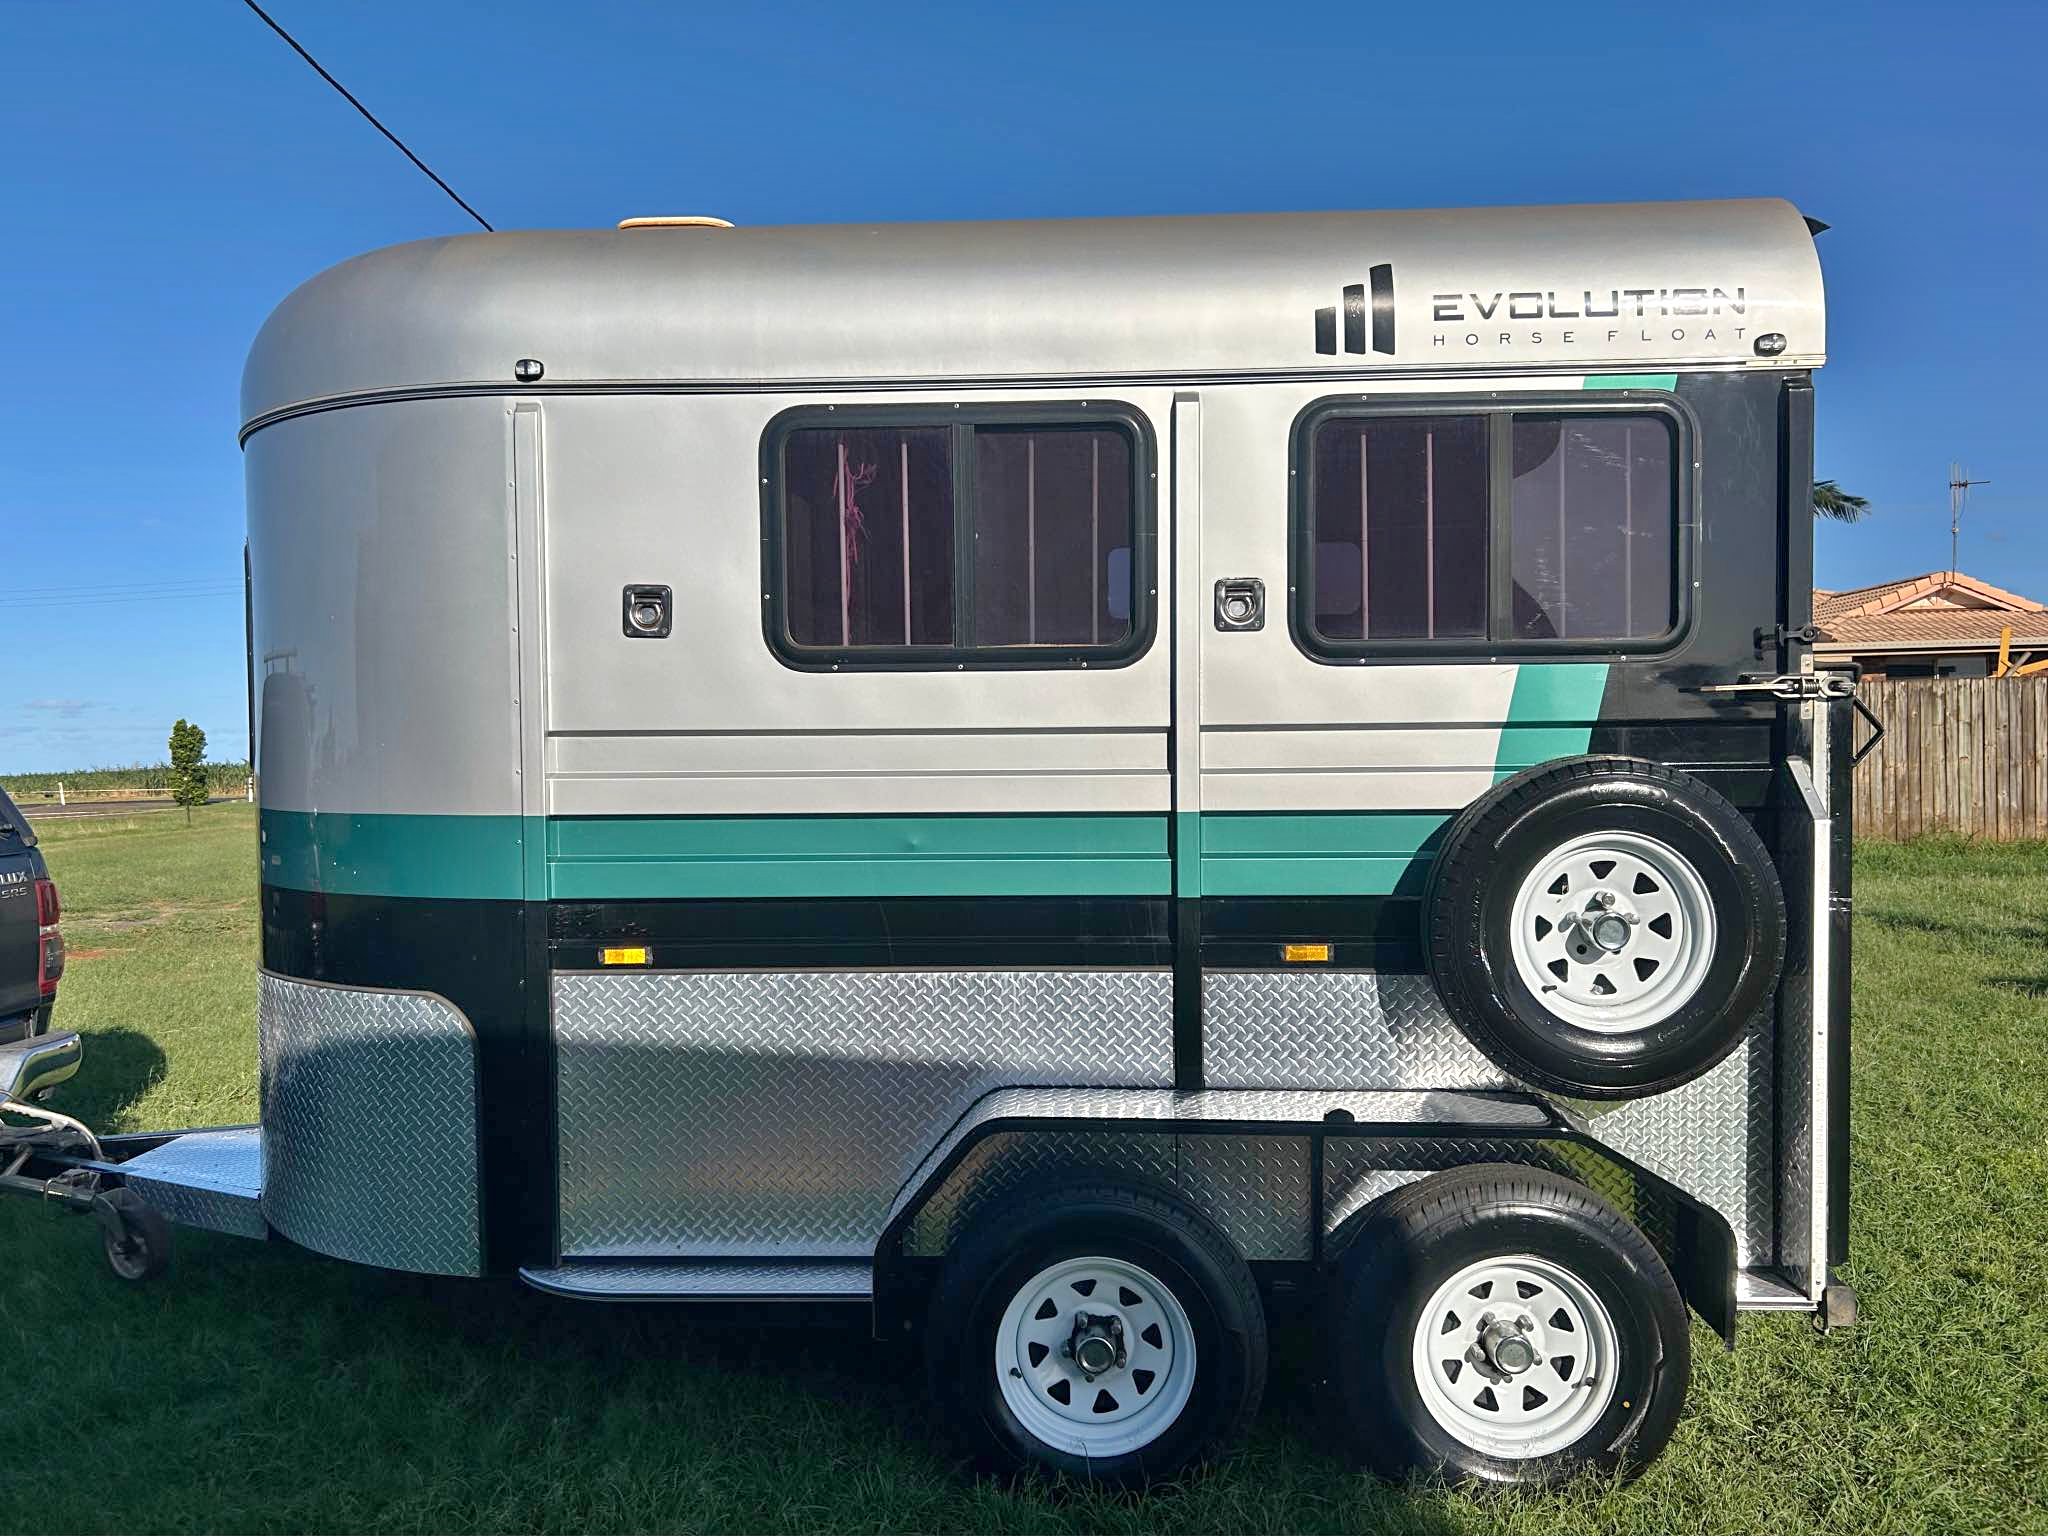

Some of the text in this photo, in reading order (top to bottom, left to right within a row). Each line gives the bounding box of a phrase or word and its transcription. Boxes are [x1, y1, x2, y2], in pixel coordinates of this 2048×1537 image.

[1432, 287, 1747, 322] EVOLUTION
[1432, 327, 1747, 347] HORSE FLOAT
